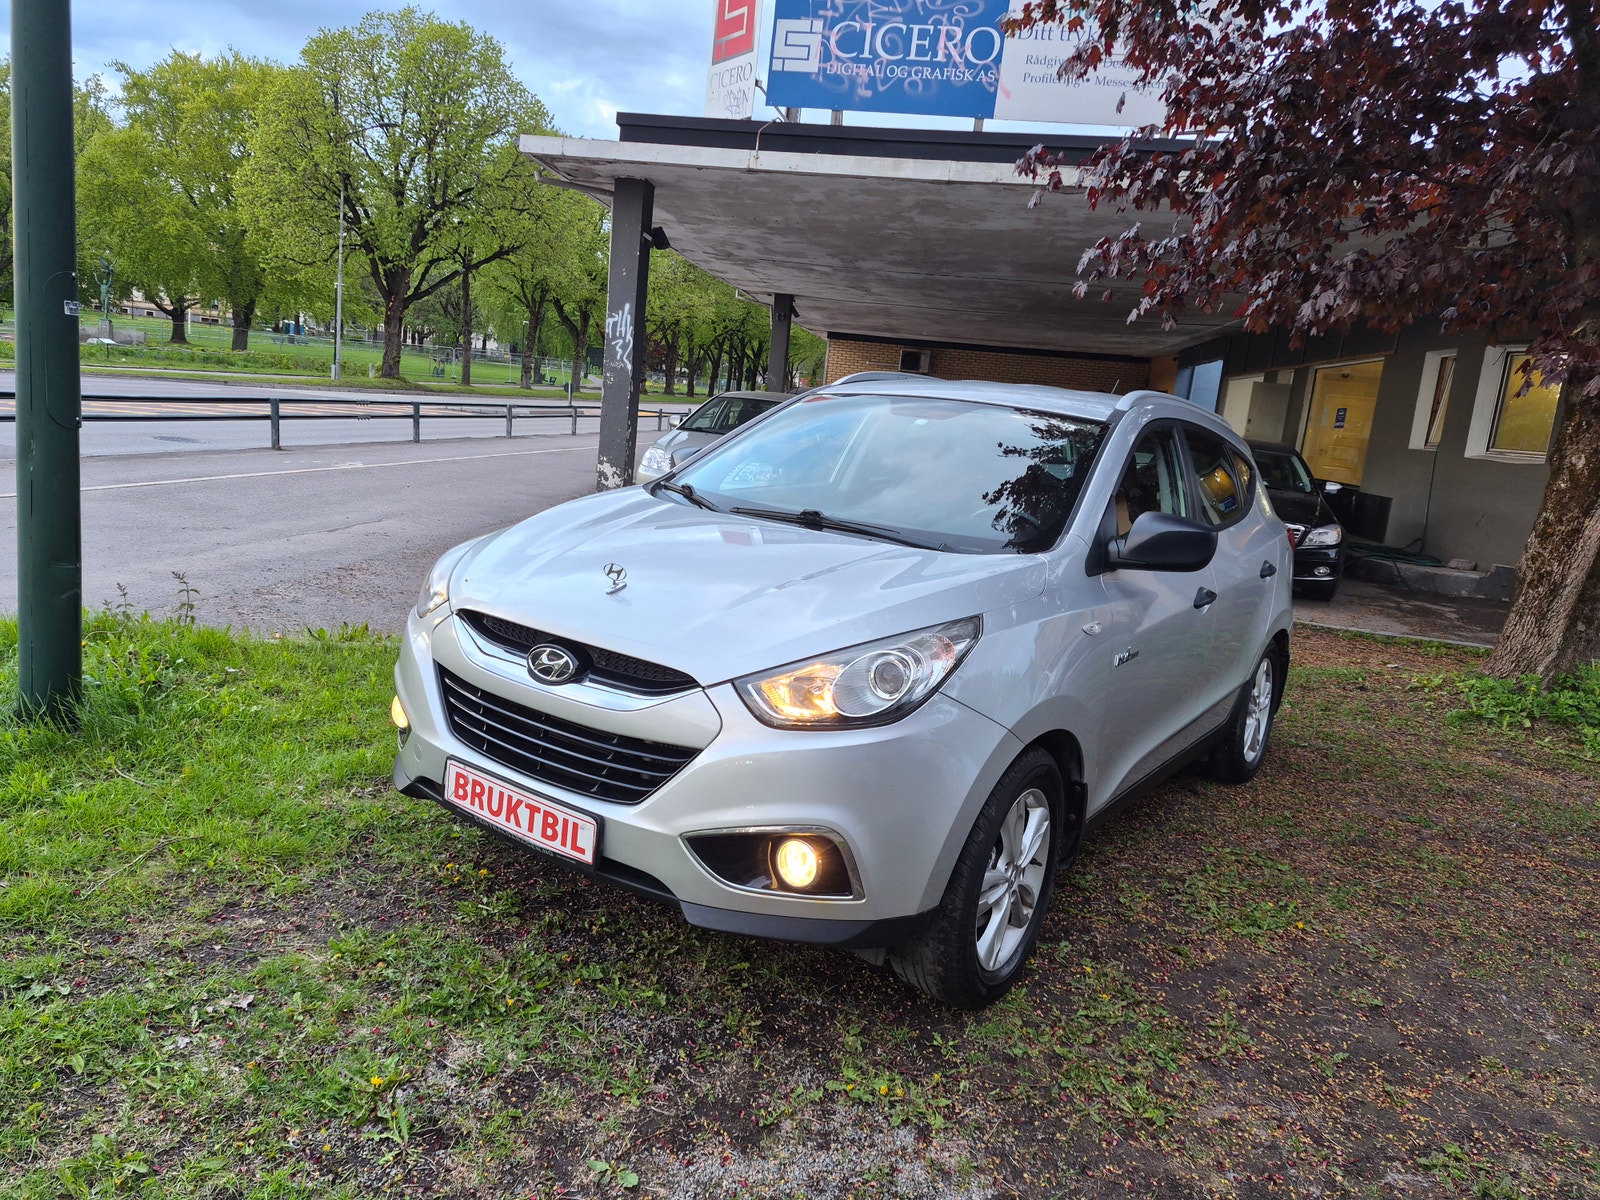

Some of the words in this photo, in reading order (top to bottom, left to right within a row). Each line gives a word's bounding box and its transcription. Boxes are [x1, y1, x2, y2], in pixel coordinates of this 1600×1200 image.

[829, 20, 1001, 64] CICERO
[1017, 23, 1054, 41] Ditt
[710, 62, 753, 91] CICERO
[826, 62, 882, 77] DIGITAL
[886, 65, 908, 79] OG
[911, 66, 974, 81] GRAFISK
[975, 68, 996, 82] AS
[453, 771, 586, 856] BRUKTBIL
